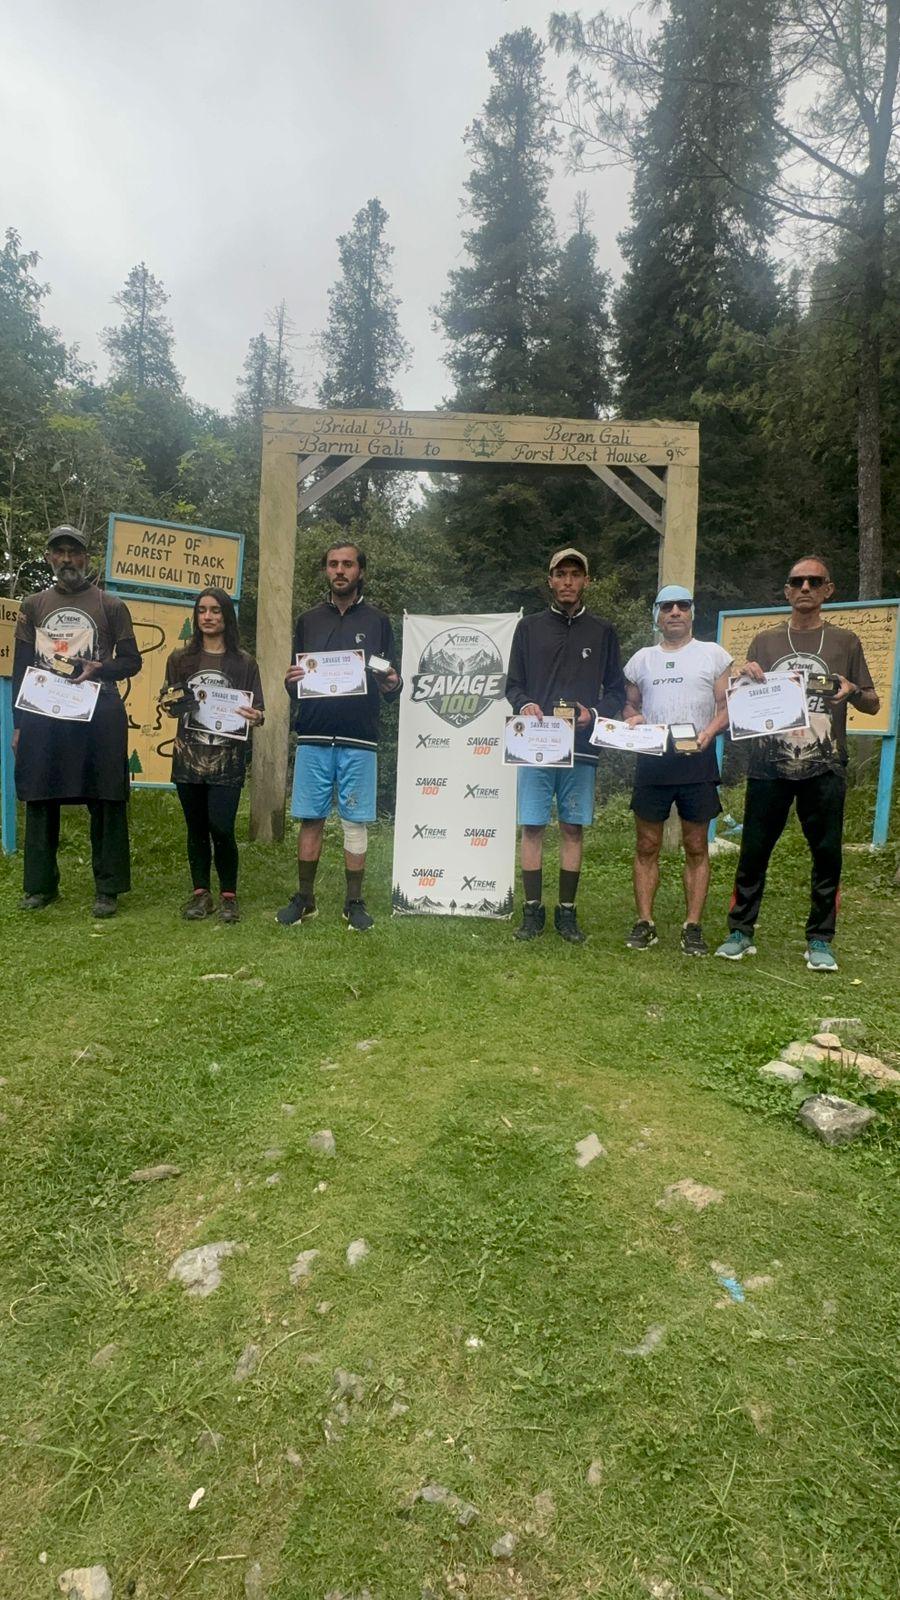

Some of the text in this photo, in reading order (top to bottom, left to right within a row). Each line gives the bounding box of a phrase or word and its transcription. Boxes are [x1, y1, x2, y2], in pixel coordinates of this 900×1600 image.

[313, 416, 414, 436] Bridal Path
[543, 423, 631, 445] Beran Gali
[299, 433, 440, 456] Barmi Gali to
[512, 444, 649, 463] Forst Rest House
[142, 530, 202, 551] MAP OF
[126, 544, 224, 569] FOREST TRACK
[116, 561, 234, 590] NAMLI GALI TO SATTU
[0, 604, 17, 621] les
[445, 633, 480, 646] XTREME
[787, 661, 815, 671] XTREME
[413, 674, 504, 700] SAVAGE
[652, 677, 684, 686] GYRO
[748, 686, 770, 697] SAVAGE
[439, 694, 480, 714] 100
[530, 721, 550, 729] SAVAGE
[416, 734, 451, 749] XTREME
[467, 737, 500, 746] SAVAGE
[473, 747, 491, 755] 100
[415, 777, 448, 787] SAVAGE
[421, 787, 439, 796] 100
[463, 784, 500, 799] XTREME
[411, 824, 448, 839] XTREME
[464, 828, 497, 838] SAVAGE
[470, 838, 488, 847] 100
[412, 868, 444, 878] SAVAGE
[418, 878, 436, 887] 100
[461, 876, 497, 891] XTREME
